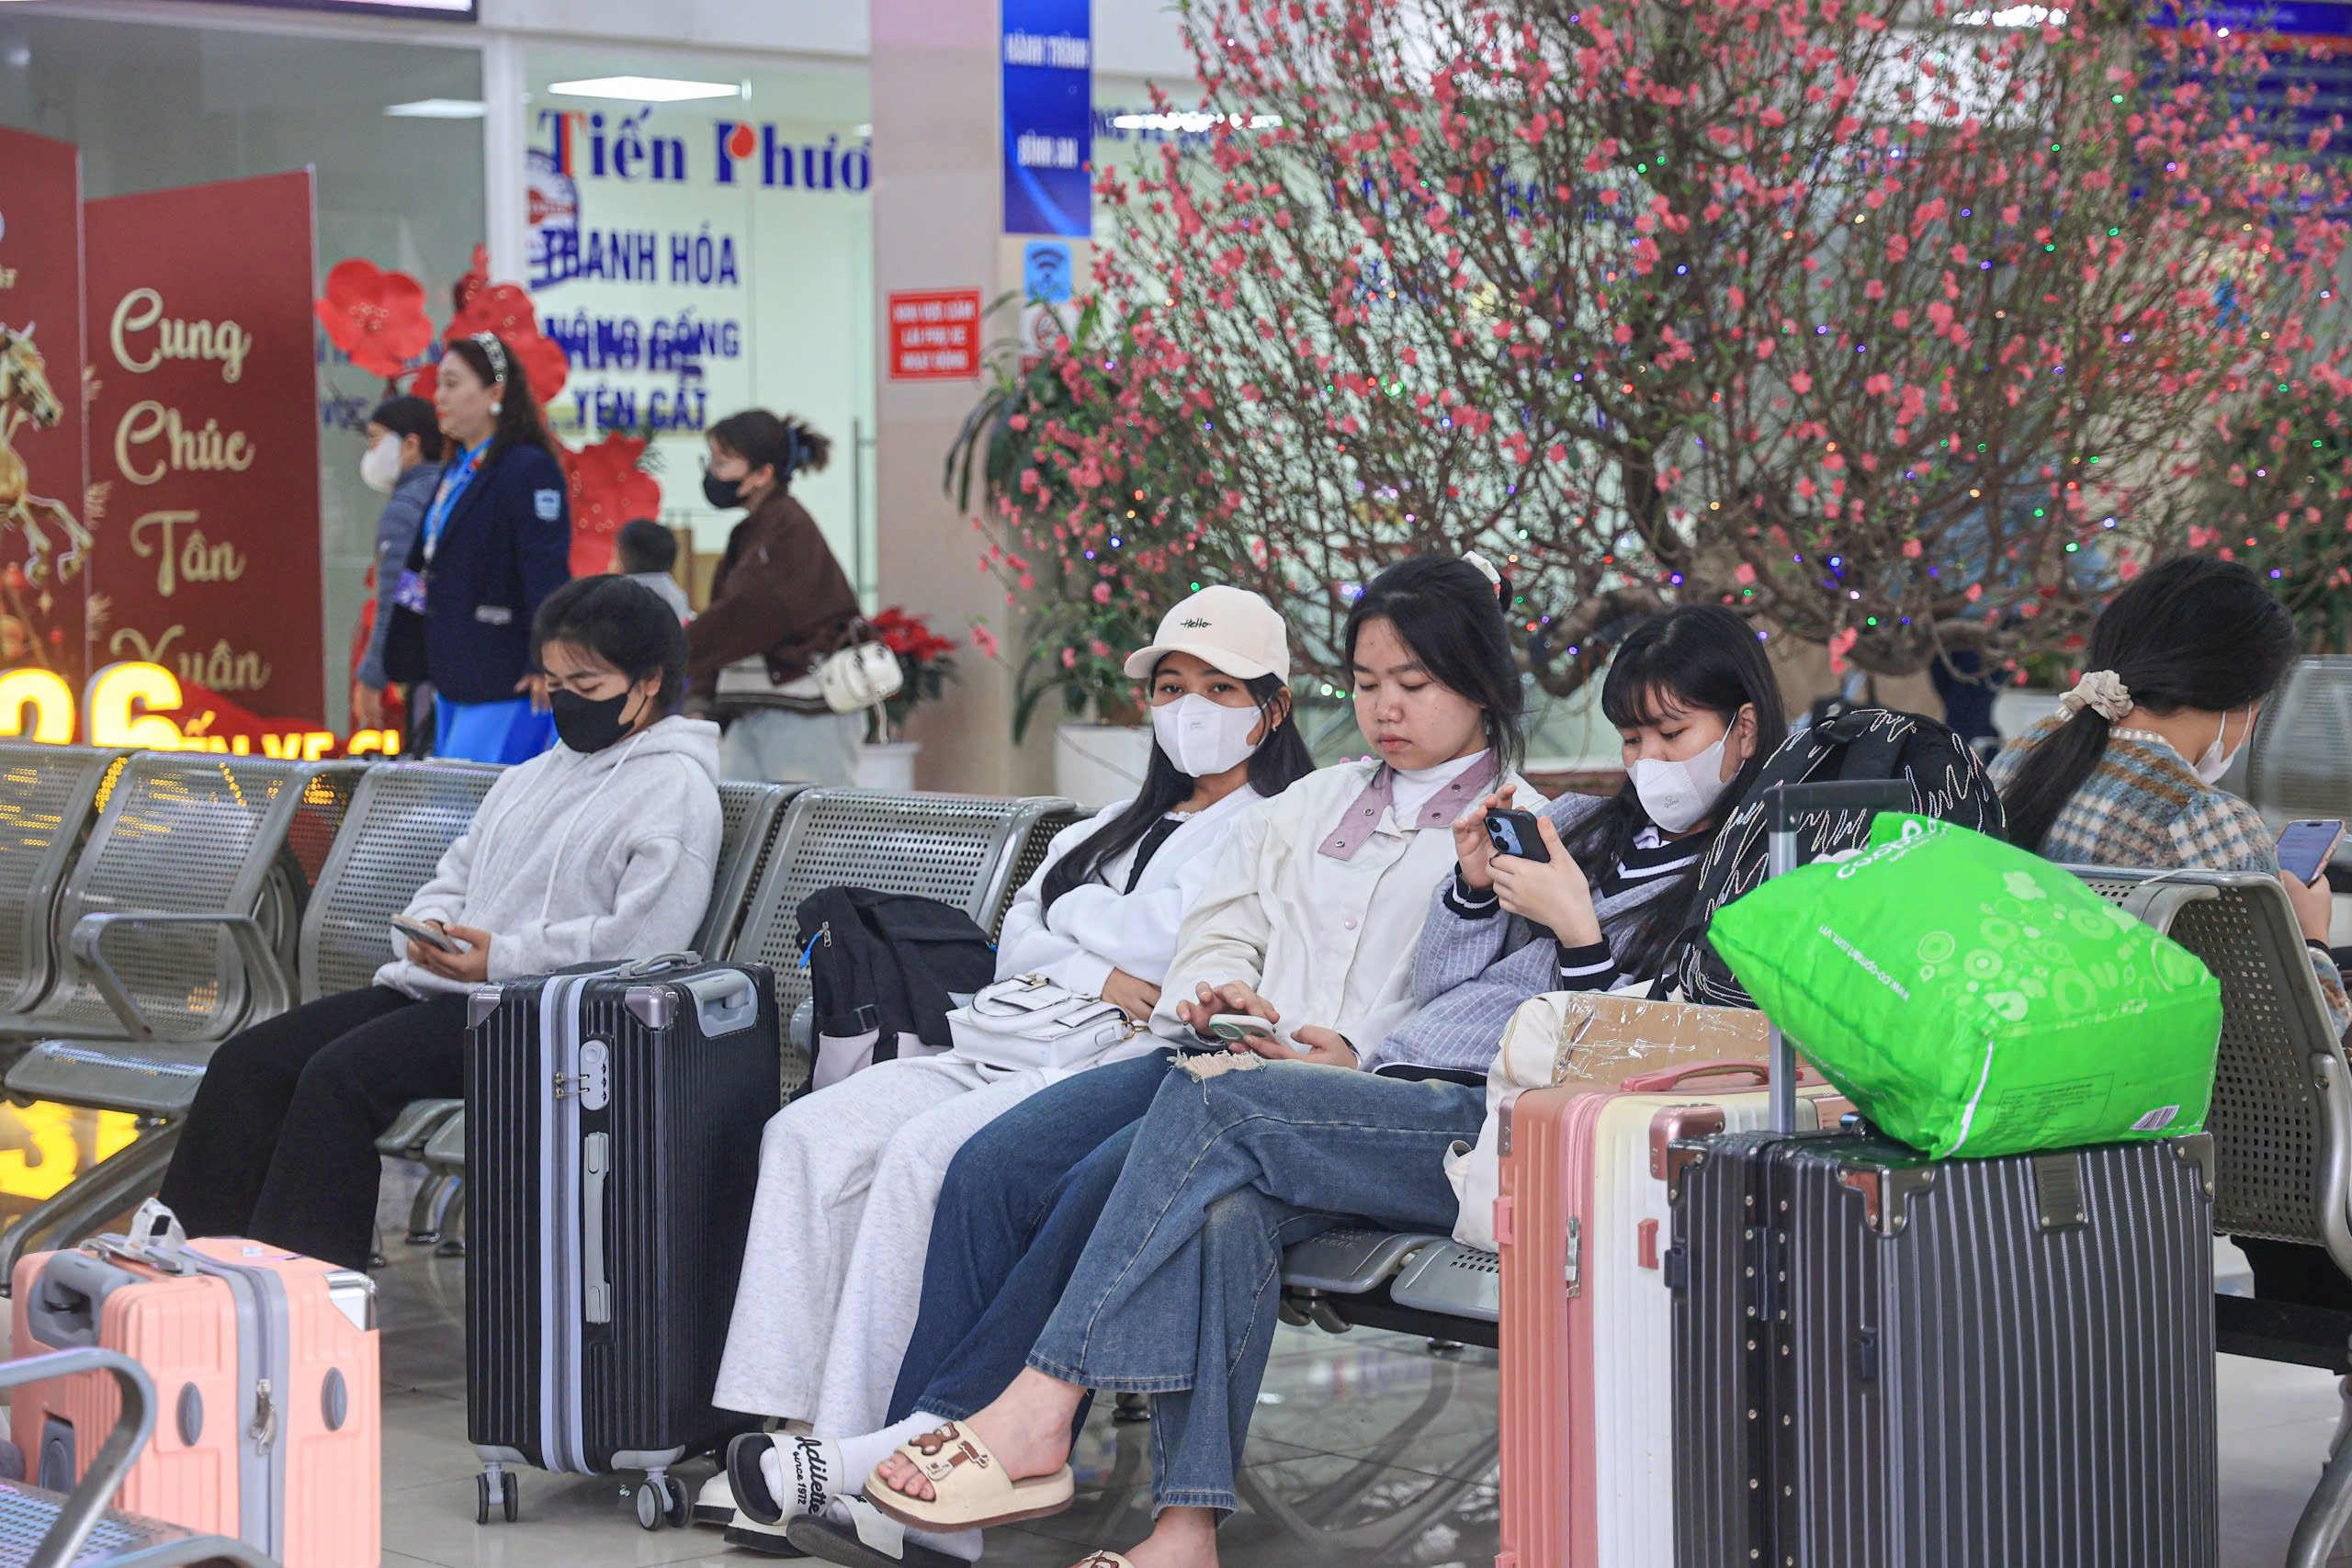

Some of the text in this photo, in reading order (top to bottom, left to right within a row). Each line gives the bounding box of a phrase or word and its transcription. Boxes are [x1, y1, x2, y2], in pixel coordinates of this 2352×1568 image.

[537, 106, 686, 183] Tiến
[670, 220, 739, 287] HÓA
[110, 287, 252, 383] Cung
[115, 400, 255, 485] Chúc
[130, 509, 246, 597] Tân
[1181, 617, 1213, 629] Hello
[793, 1450, 808, 1505] since 1972
[795, 1436, 829, 1514] Adilette
